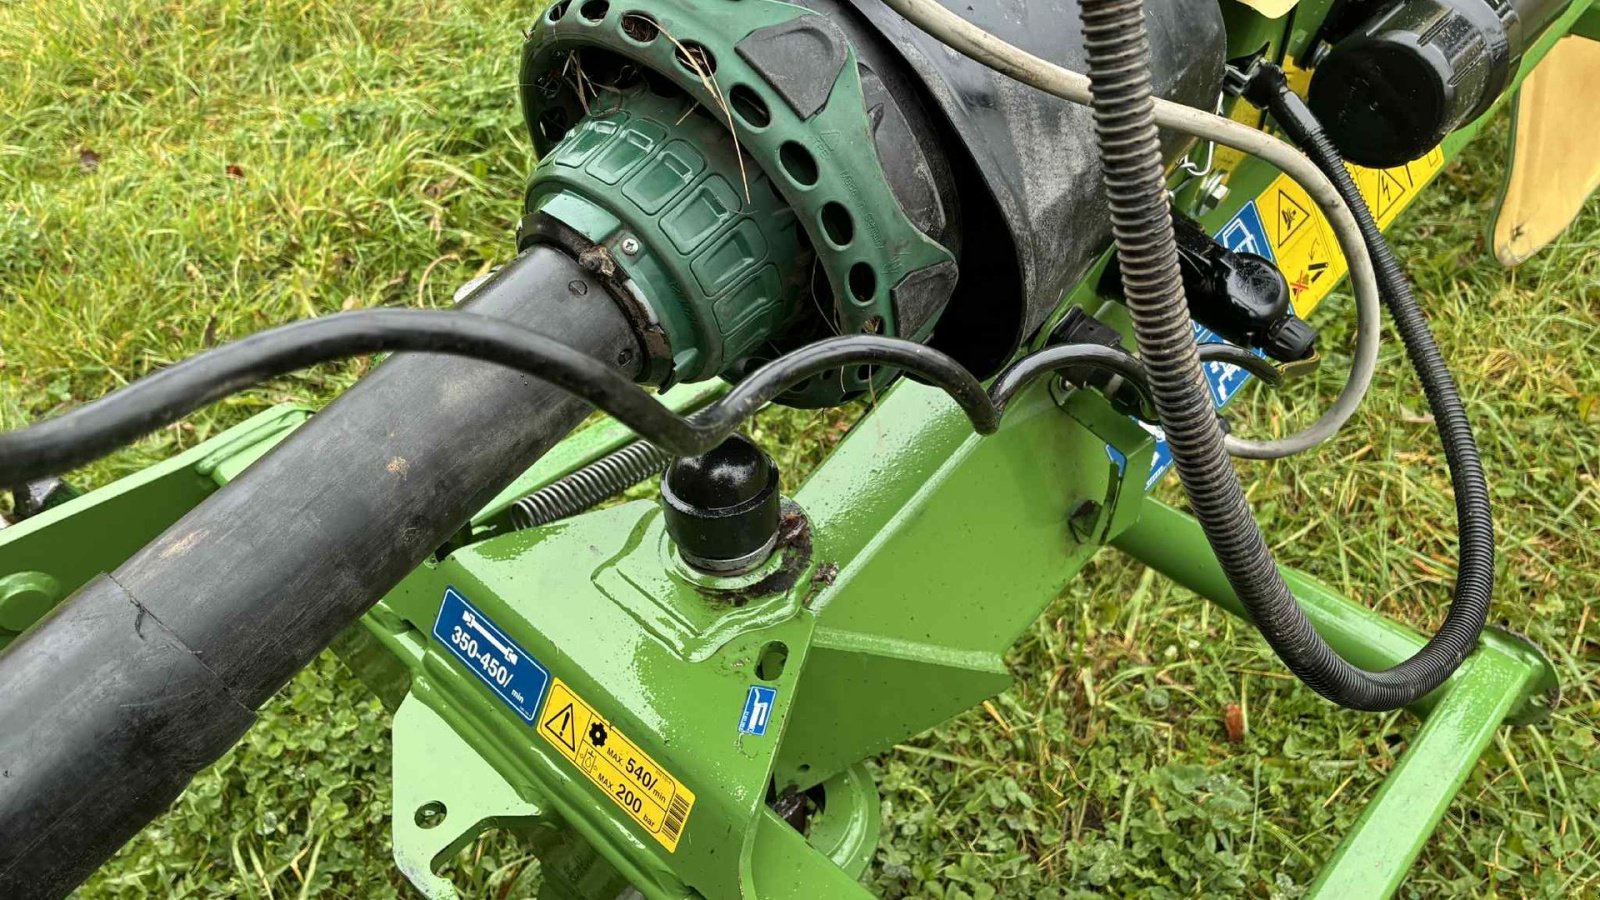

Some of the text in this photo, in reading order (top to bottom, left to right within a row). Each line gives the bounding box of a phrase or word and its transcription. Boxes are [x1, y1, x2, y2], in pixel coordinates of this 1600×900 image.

[511, 689, 524, 704] min
[597, 773, 656, 828] MAX. 200 bar
[606, 747, 624, 767] MAX.
[652, 788, 667, 803] min
